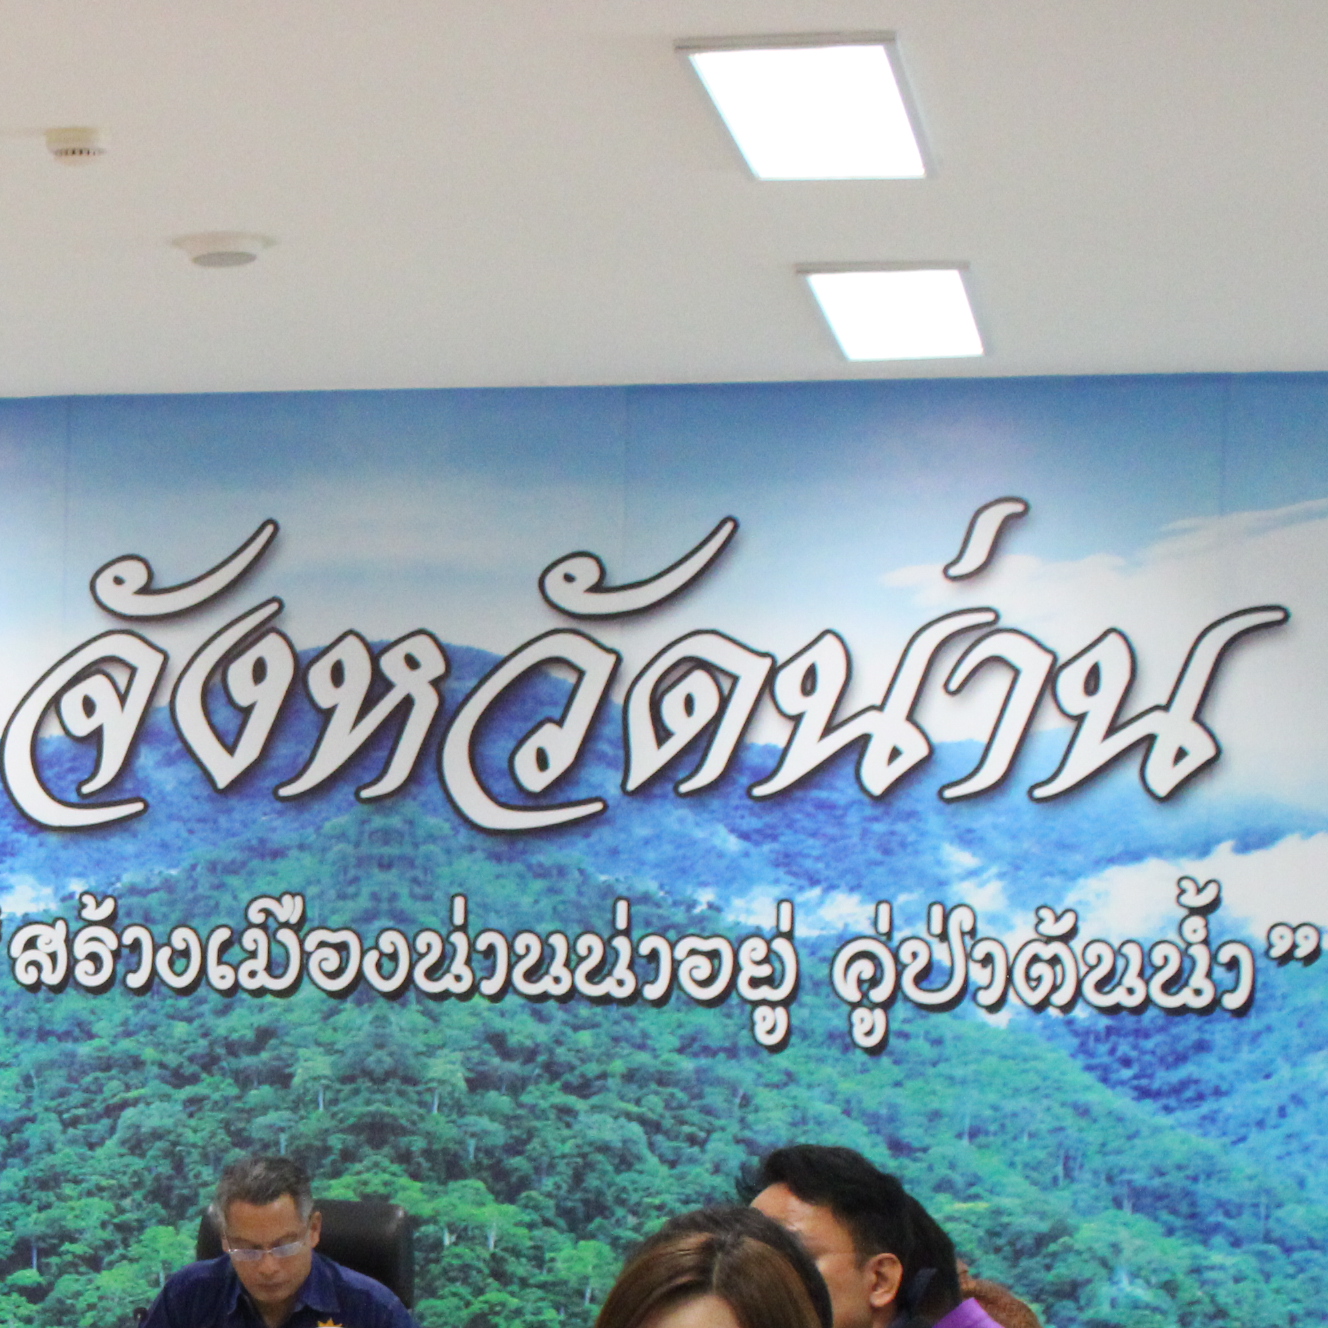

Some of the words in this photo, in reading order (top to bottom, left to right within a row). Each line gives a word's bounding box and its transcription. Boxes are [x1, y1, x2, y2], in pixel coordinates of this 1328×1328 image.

[0, 497, 1290, 833] จังหวัดน่าน
